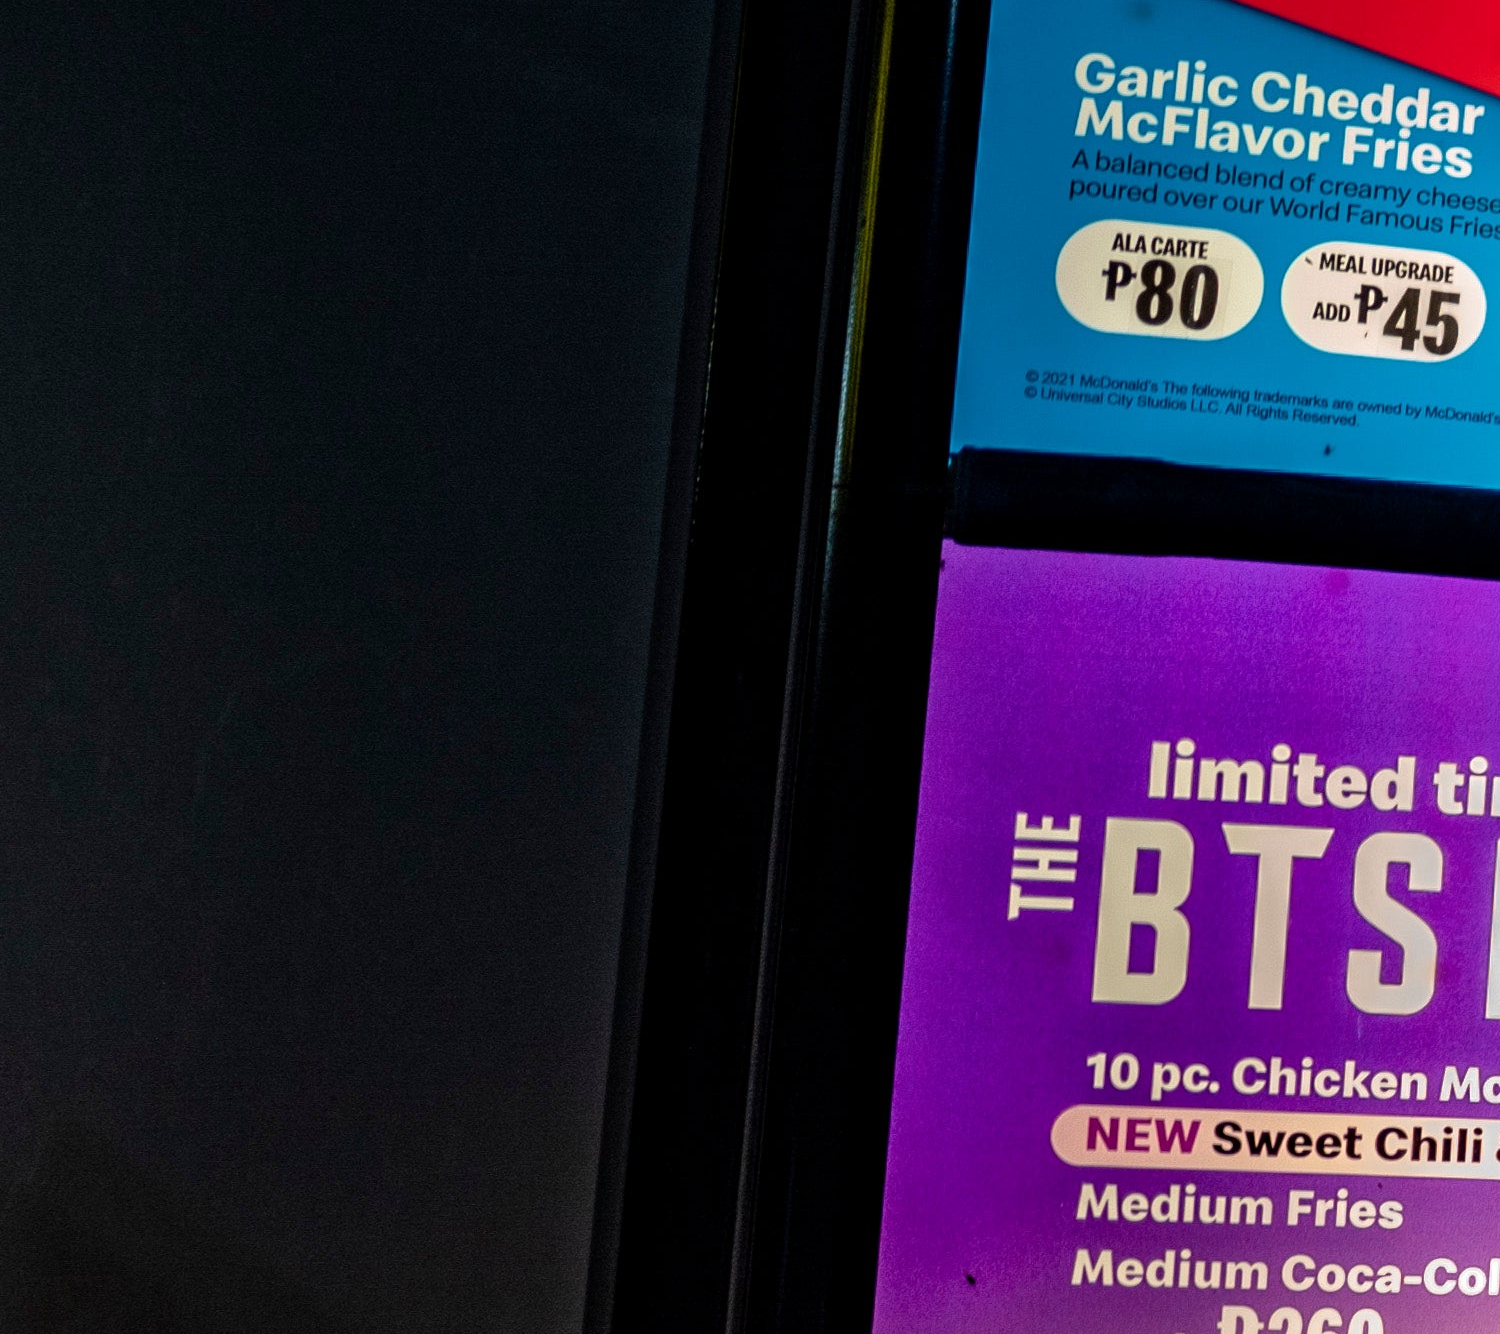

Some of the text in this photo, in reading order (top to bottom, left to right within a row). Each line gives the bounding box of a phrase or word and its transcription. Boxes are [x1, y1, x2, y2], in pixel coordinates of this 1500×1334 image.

[1075, 52, 1485, 135] Garlic Cheddar
[1074, 97, 1473, 178] McFlavor Fries
[1071, 150, 1089, 169] A
[1095, 149, 1209, 183] balanced
[1216, 163, 1283, 190] blend
[1290, 173, 1316, 192] of
[1320, 180, 1414, 207] creamy
[1069, 177, 1158, 204] poured
[1163, 191, 1219, 210] over
[1222, 197, 1265, 215] our
[1270, 198, 1339, 223] World
[1346, 205, 1443, 234] Famous
[1112, 234, 1209, 260] ALA CARTE
[1319, 253, 1454, 283] MEAL UPGRADE
[1313, 301, 1351, 322] ADD
[1041, 387, 1103, 404] Universal
[1107, 392, 1133, 408] City
[1137, 394, 1187, 412] Studios
[1225, 402, 1242, 416] All
[1246, 405, 1289, 420] Rights
[1292, 410, 1360, 427] Reserved.
[1042, 372, 1075, 386] 2021
[1080, 375, 1158, 393] McDonald's
[1162, 381, 1188, 395] The
[1192, 384, 1249, 402] following
[1254, 389, 1328, 409] trademarks
[1332, 399, 1353, 411] are
[1358, 401, 1401, 416] owned
[1406, 404, 1422, 419] by
[1425, 406, 1500, 425] McDonald's
[1147, 736, 1418, 814] limited
[1007, 810, 1081, 920] THE
[1091, 816, 1445, 1017] BTS
[1085, 1051, 1141, 1093] 10
[1151, 1062, 1221, 1103] pc.
[1231, 1055, 1430, 1103] Chicken
[1084, 1114, 1200, 1157] NEW
[1211, 1119, 1363, 1161] Sweet
[1374, 1126, 1485, 1167] Chili
[1075, 1182, 1404, 1231] Medium Fries
[1070, 1248, 1270, 1290] Medium
